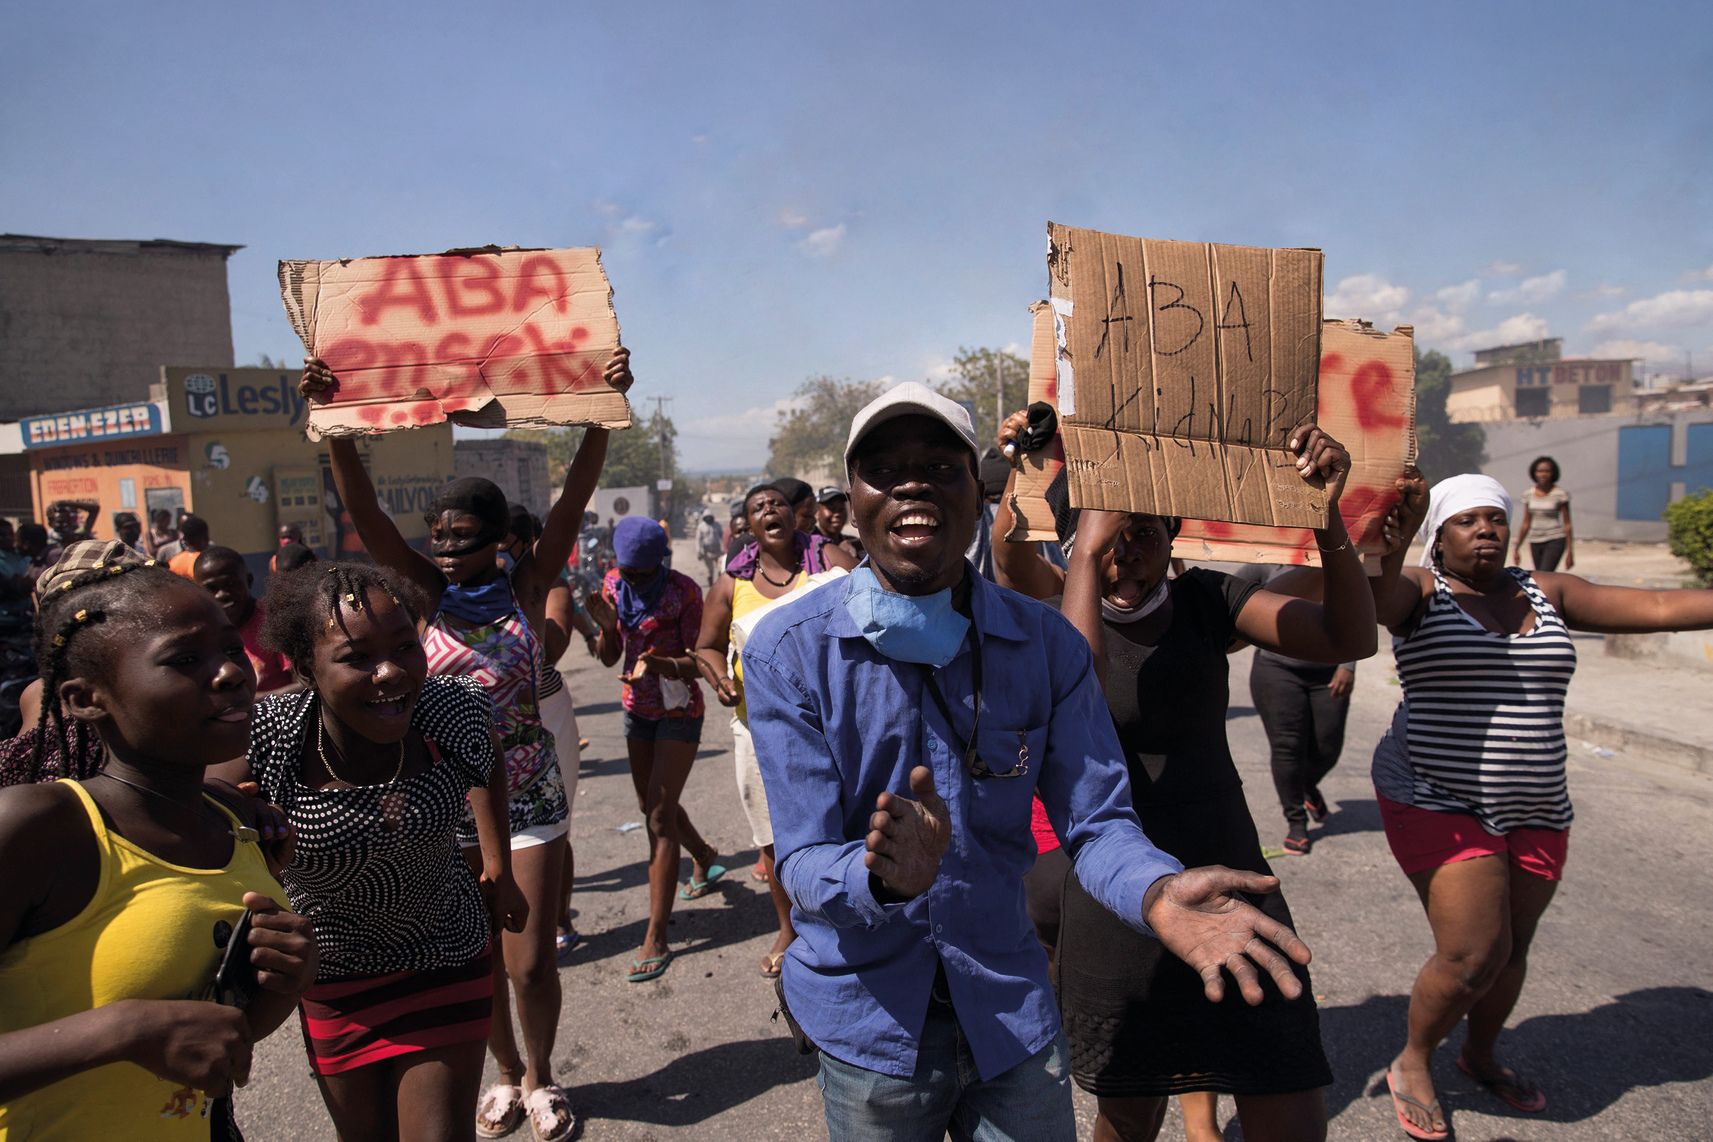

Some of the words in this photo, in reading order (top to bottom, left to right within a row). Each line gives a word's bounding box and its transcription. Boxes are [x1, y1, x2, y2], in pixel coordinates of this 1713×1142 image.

[357, 255, 568, 327] ABA
[1095, 262, 1253, 362] ABA
[218, 373, 304, 426] Lesly
[1516, 366, 1551, 385] HT
[1553, 364, 1622, 385] BETON
[188, 394, 217, 416] LC
